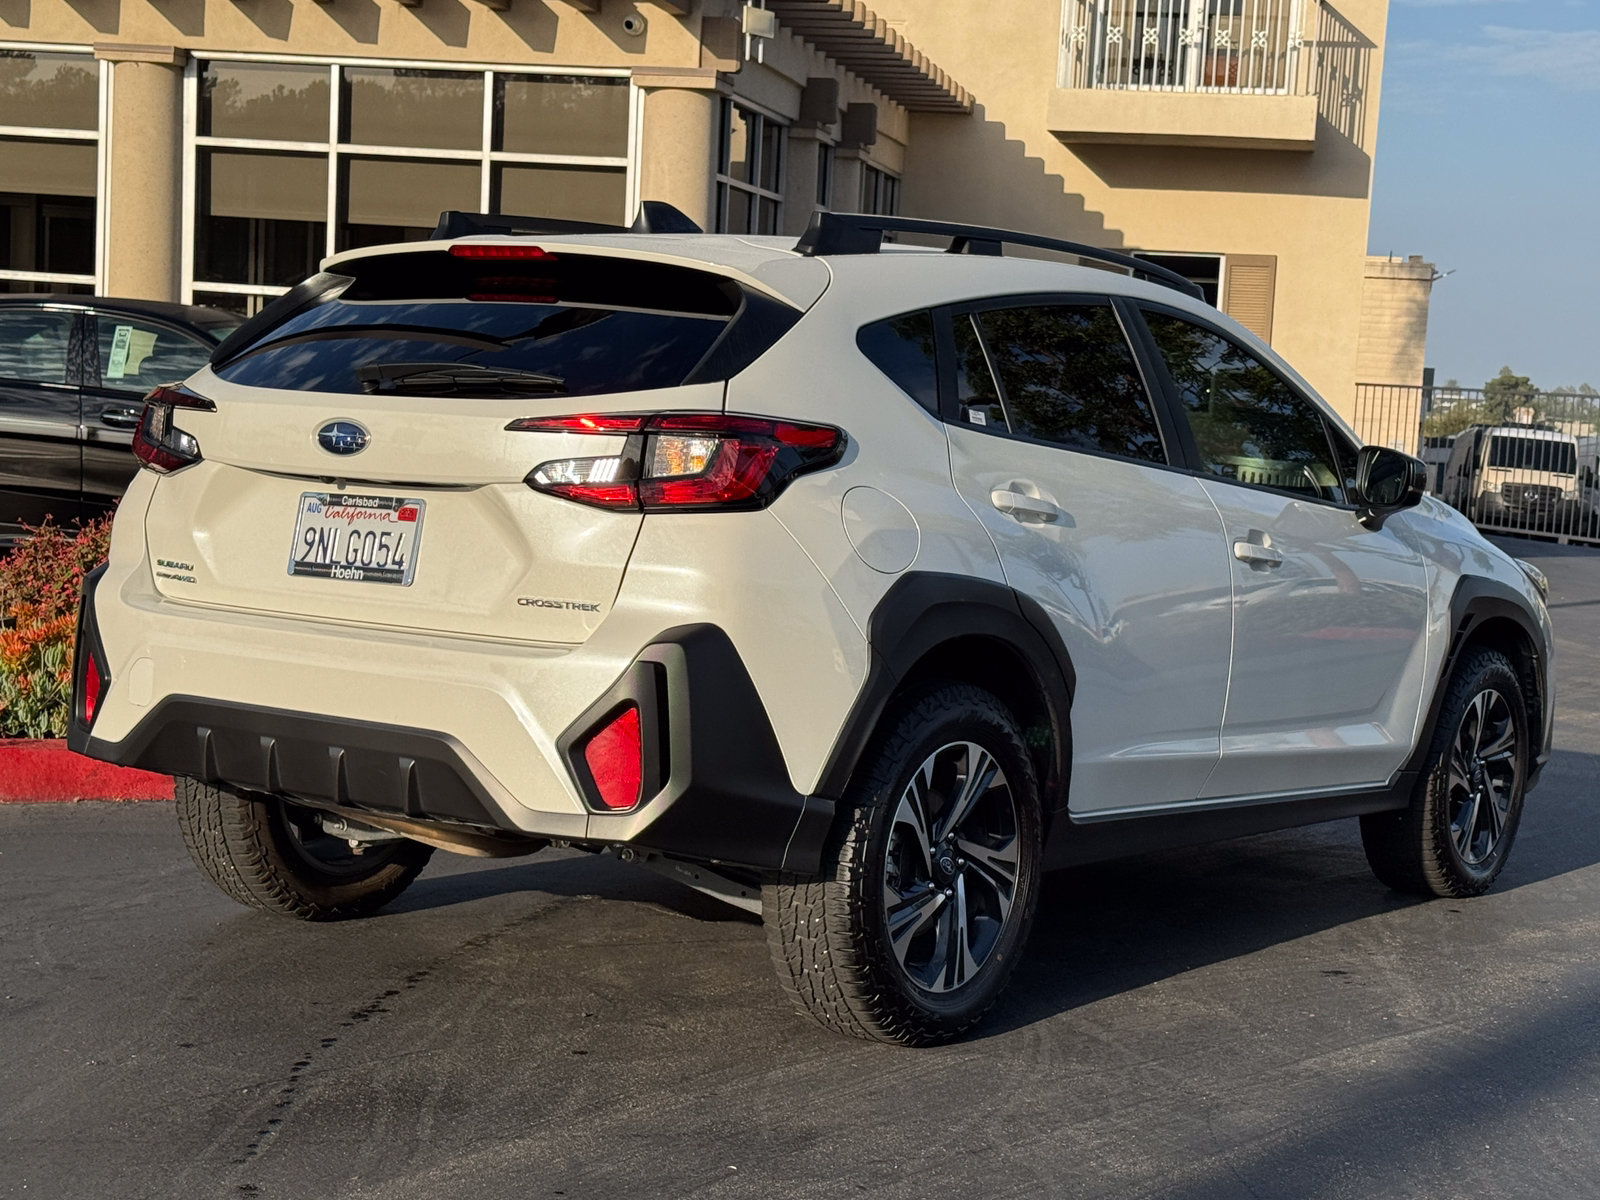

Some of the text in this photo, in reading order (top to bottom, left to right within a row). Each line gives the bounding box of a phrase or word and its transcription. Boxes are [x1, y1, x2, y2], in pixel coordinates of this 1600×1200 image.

[306, 502, 322, 514] AUG
[341, 496, 379, 508] Carlsbad
[324, 505, 399, 526] California
[300, 527, 405, 570] 9NLG054
[156, 559, 194, 571] SUBARU
[330, 565, 364, 580] Hoehn
[517, 598, 601, 612] CROSSTREK
